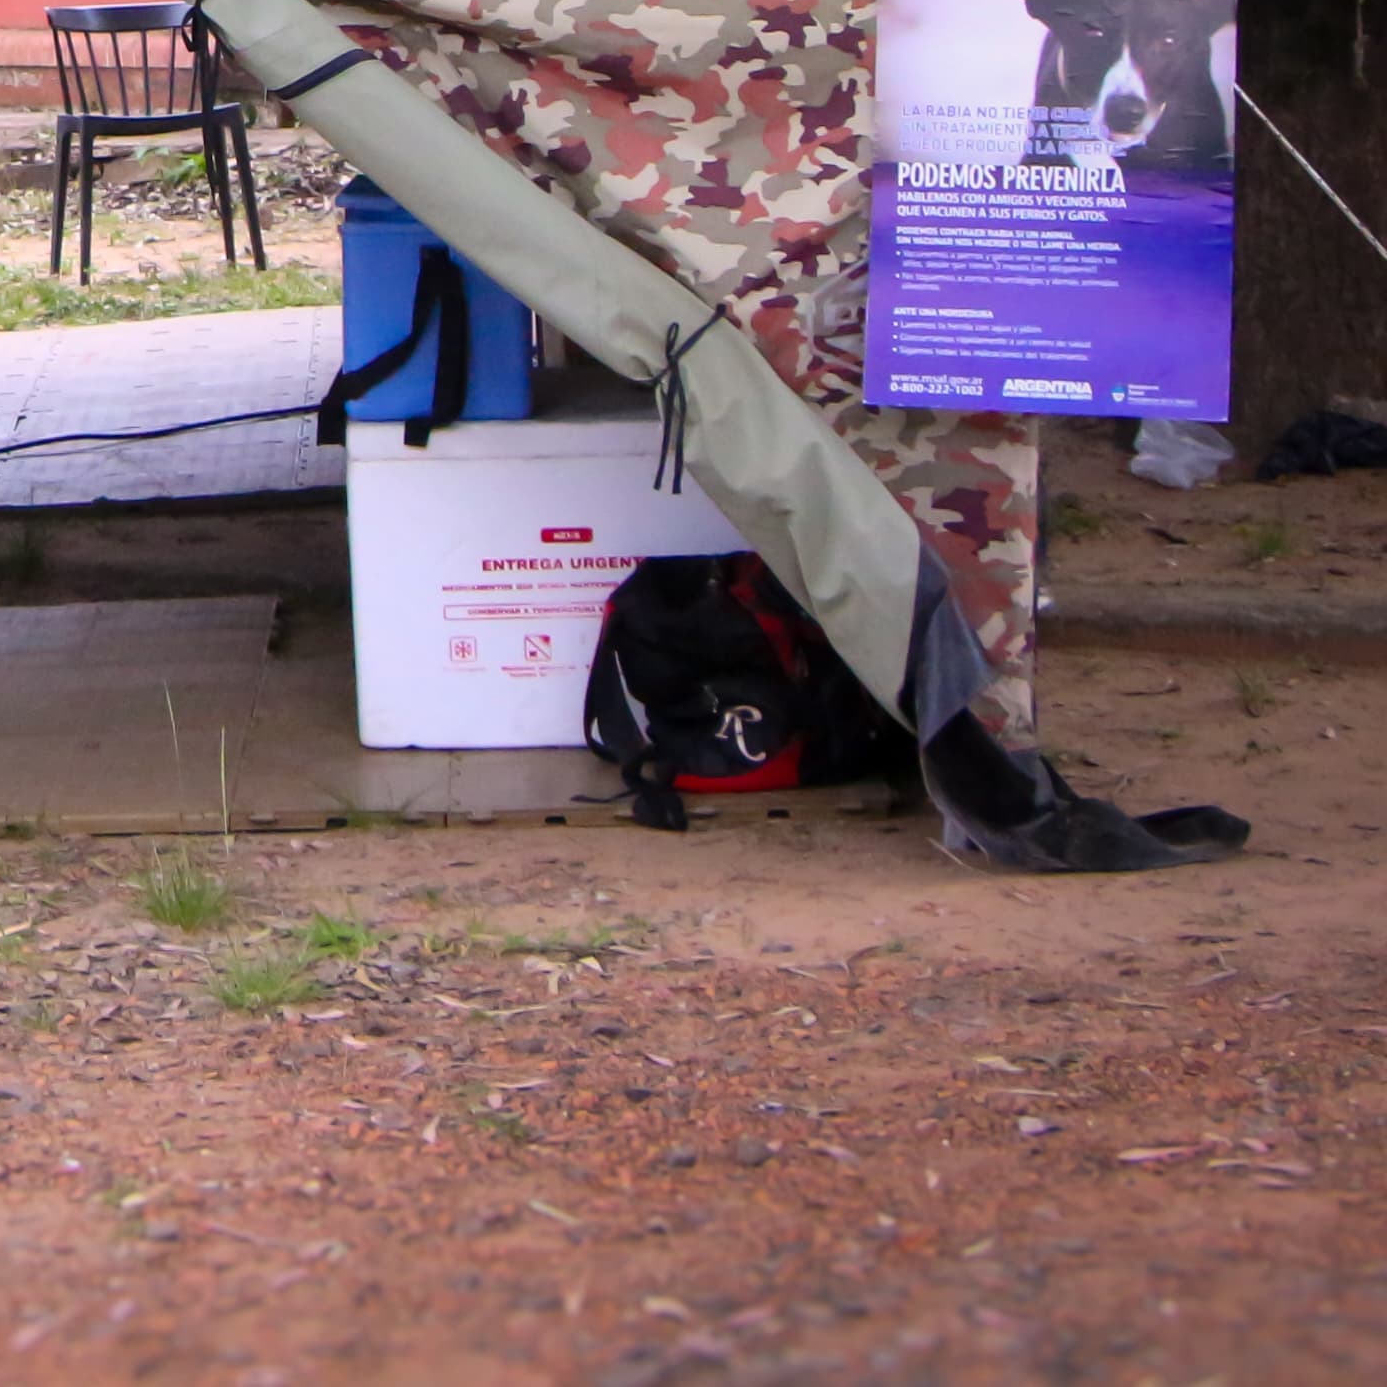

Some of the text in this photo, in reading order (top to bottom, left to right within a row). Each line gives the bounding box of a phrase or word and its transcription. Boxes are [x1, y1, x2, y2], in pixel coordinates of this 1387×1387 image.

[902, 105, 921, 117] LA
[926, 105, 972, 118] RABIA
[976, 106, 998, 119] NO
[897, 162, 1126, 193] PODEMOS PREVENIRLA
[897, 191, 960, 204] HABLEMOS
[961, 193, 987, 205] CON
[988, 194, 1034, 206] AMIGOS
[1045, 195, 1094, 208] VECINOS
[1096, 197, 1127, 209] PARA
[896, 204, 921, 217] QUE
[922, 205, 976, 219] VACUNEN
[988, 207, 1012, 220] SUS
[1003, 379, 1092, 394] ARGENTINA
[482, 555, 647, 572] ENTREGA URGENT
